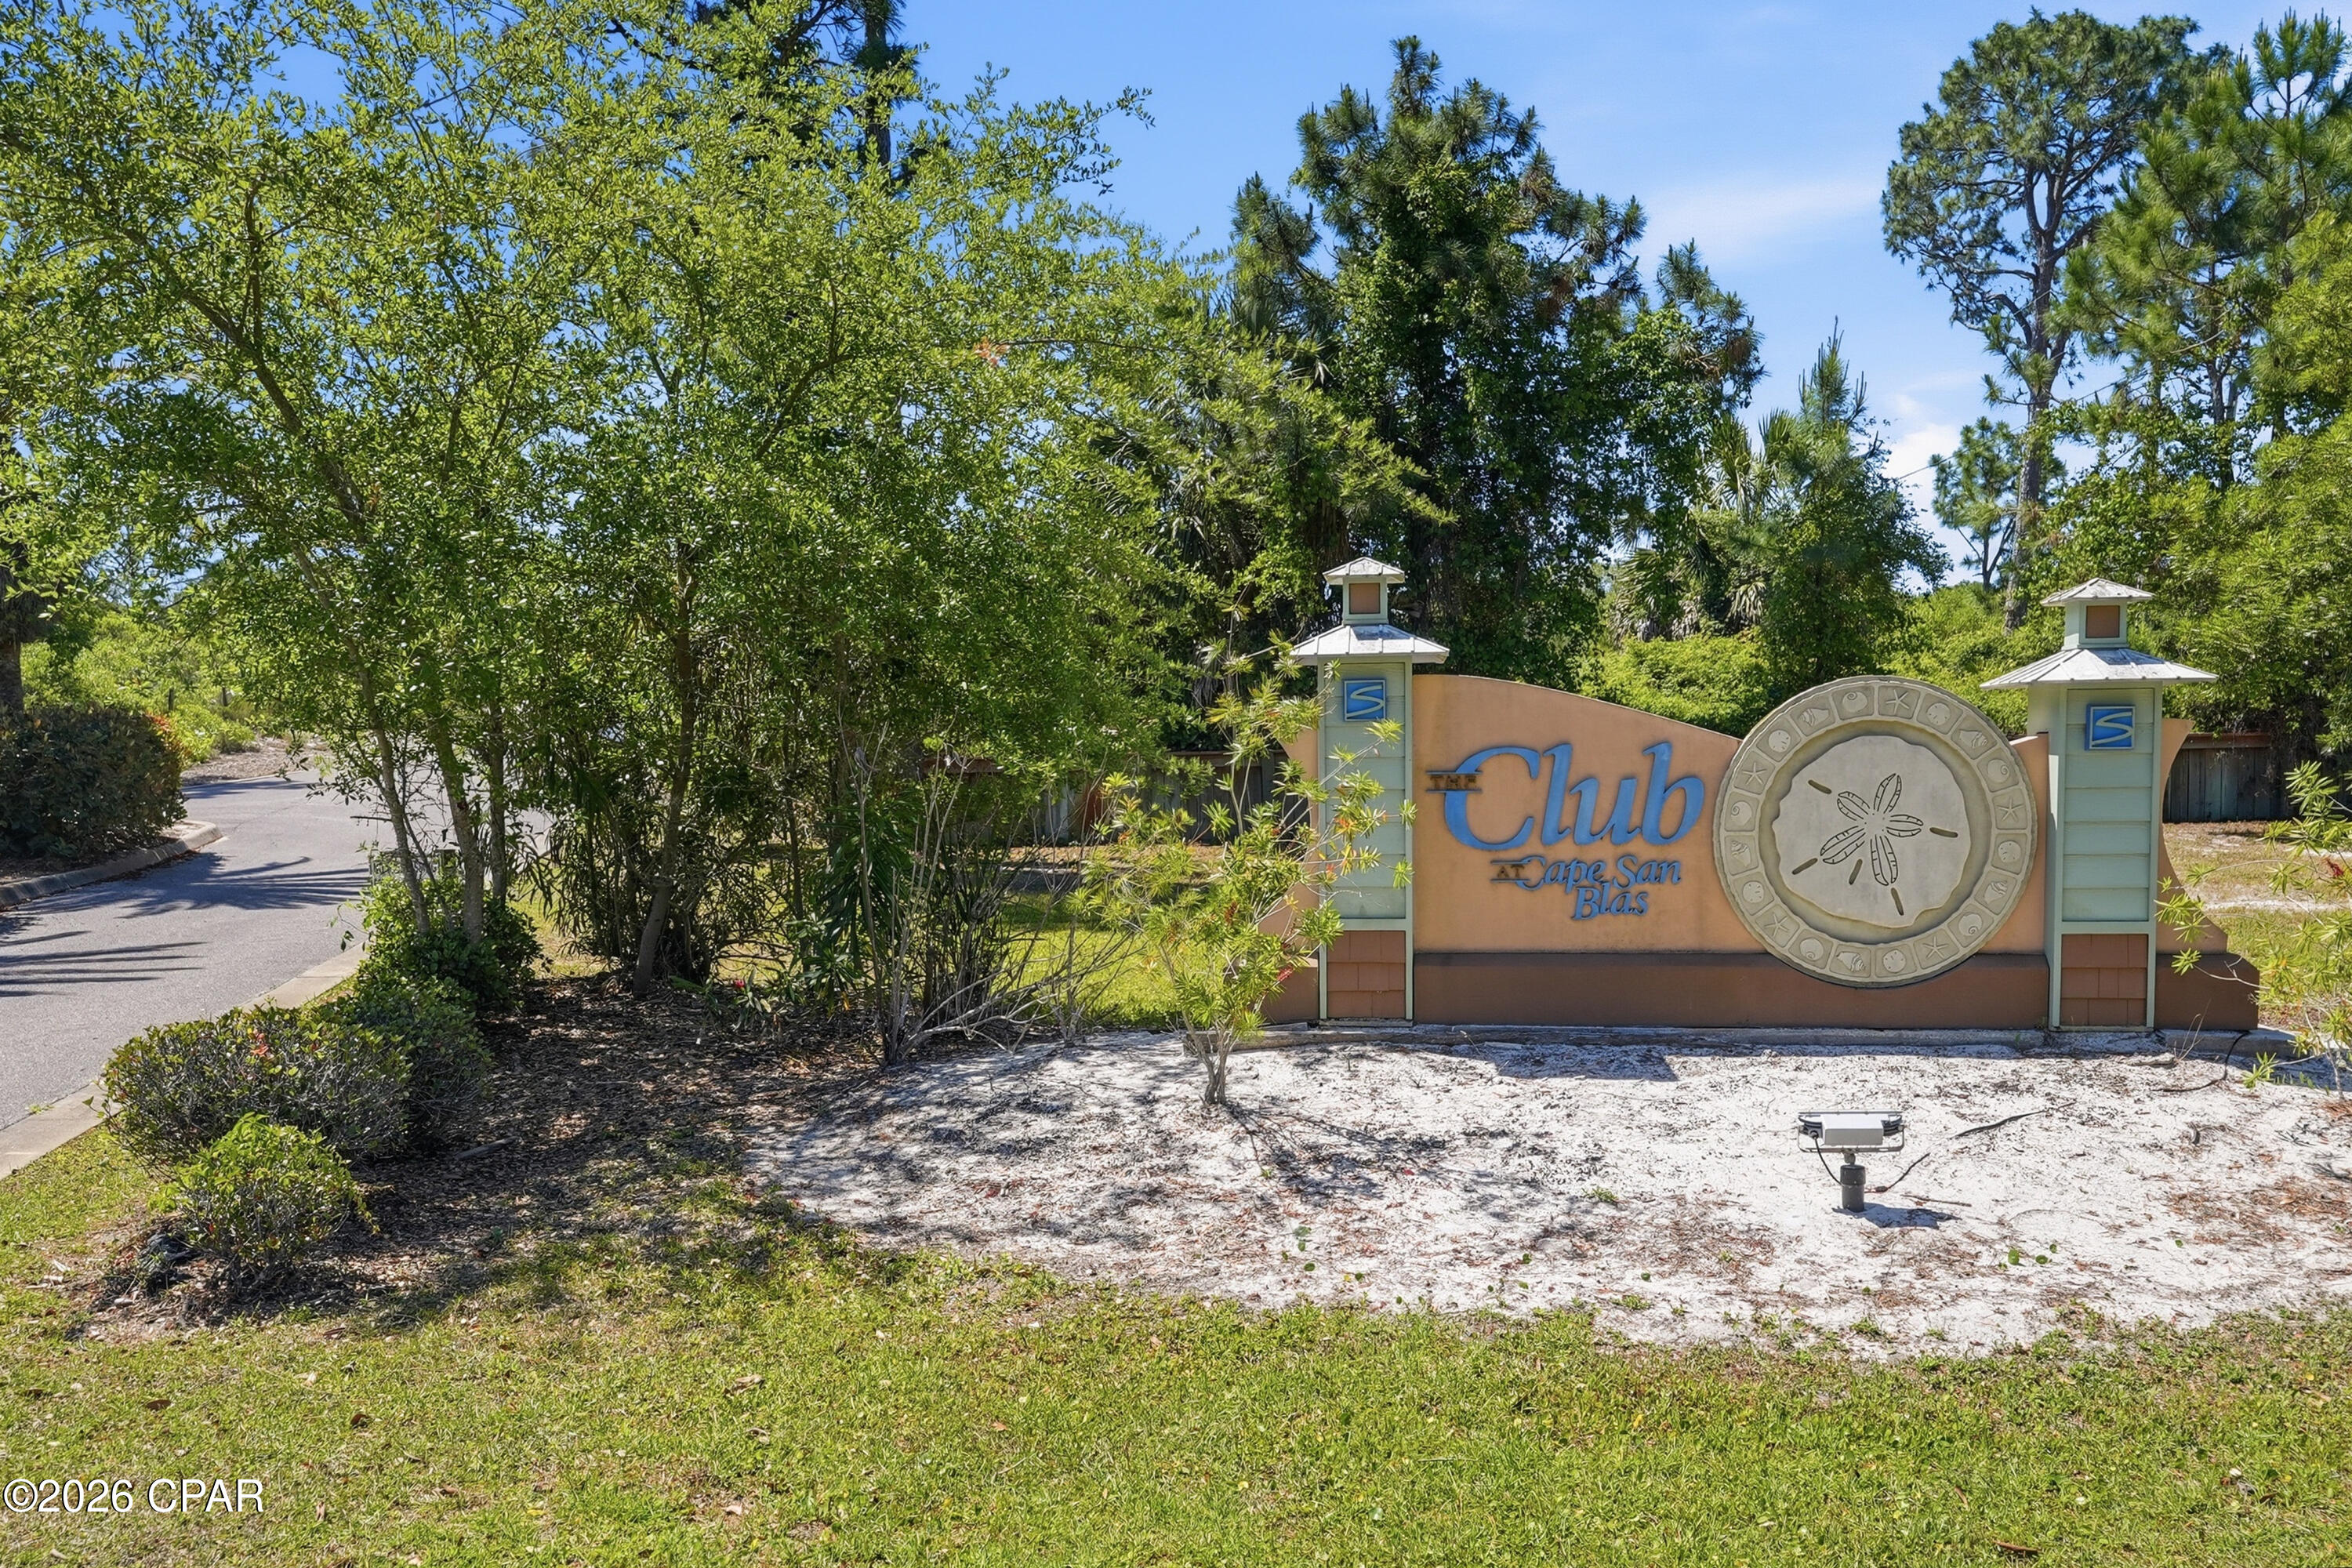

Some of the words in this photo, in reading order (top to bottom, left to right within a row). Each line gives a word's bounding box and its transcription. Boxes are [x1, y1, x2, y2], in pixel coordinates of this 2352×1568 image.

[1429, 775, 1477, 789] THE
[1444, 742, 1705, 851] Club
[1497, 864, 1525, 879] AT
[1515, 855, 1606, 895] Cape
[1612, 854, 1682, 890] San
[1570, 882, 1649, 920] Blas
